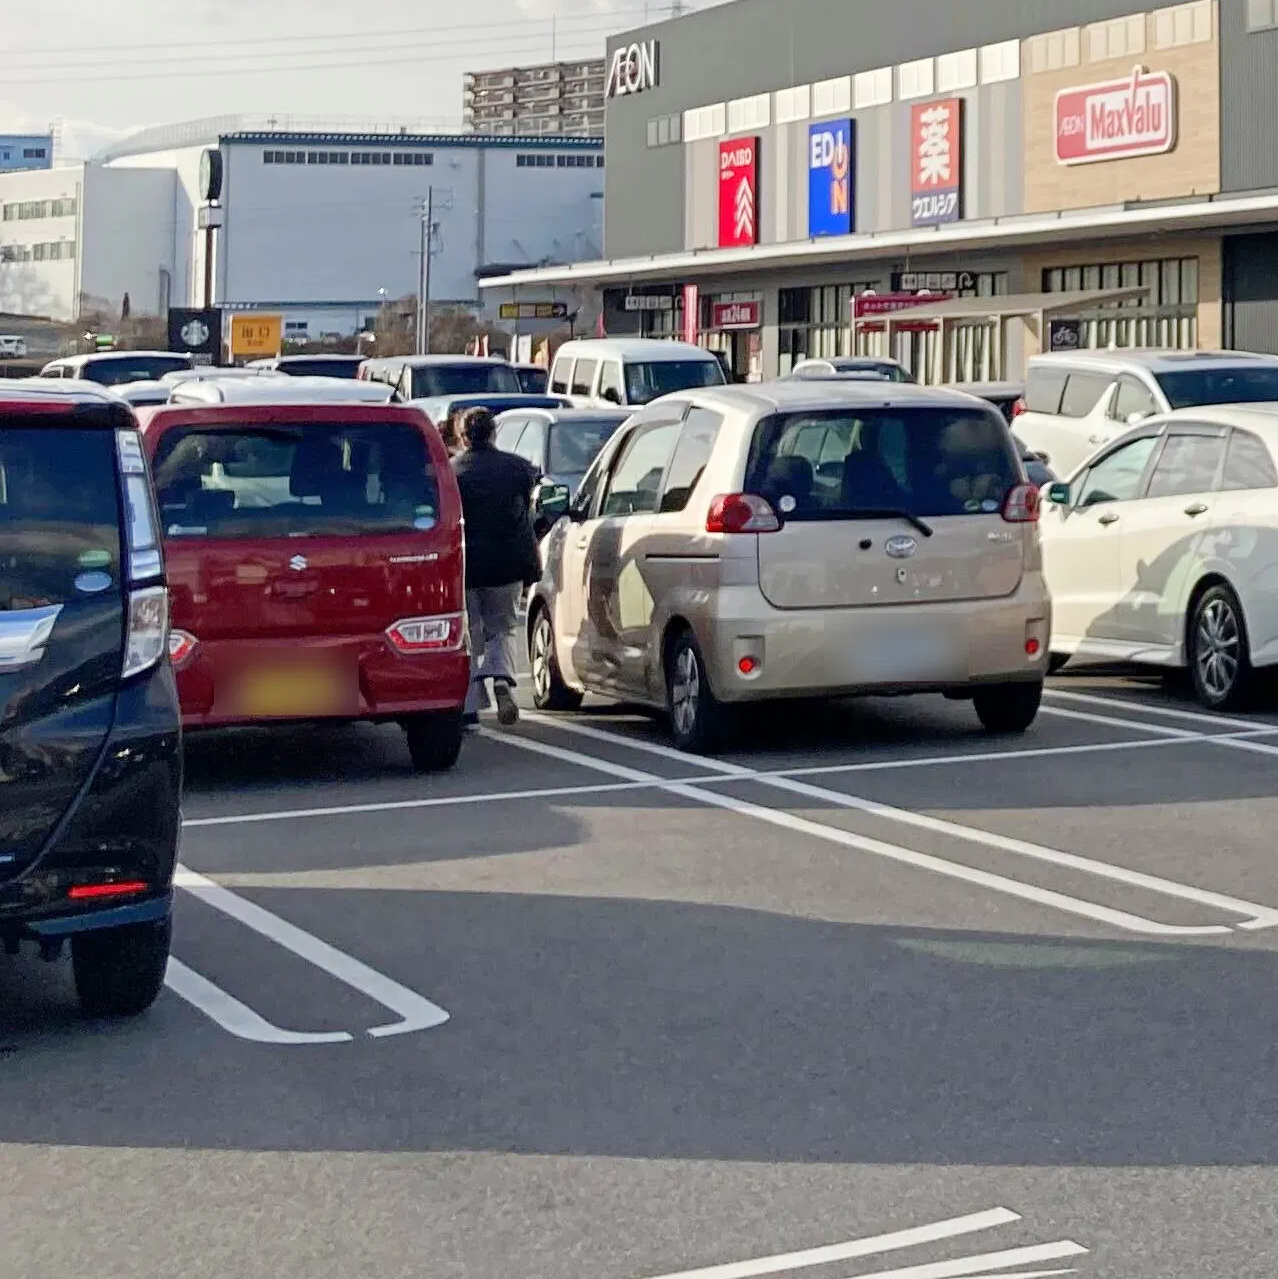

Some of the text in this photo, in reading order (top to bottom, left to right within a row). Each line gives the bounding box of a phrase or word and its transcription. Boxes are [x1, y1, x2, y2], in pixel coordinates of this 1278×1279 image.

[1091, 69, 1163, 141] MaxValu
[918, 105, 951, 185] 薬
[912, 192, 958, 220] ウエルシア
